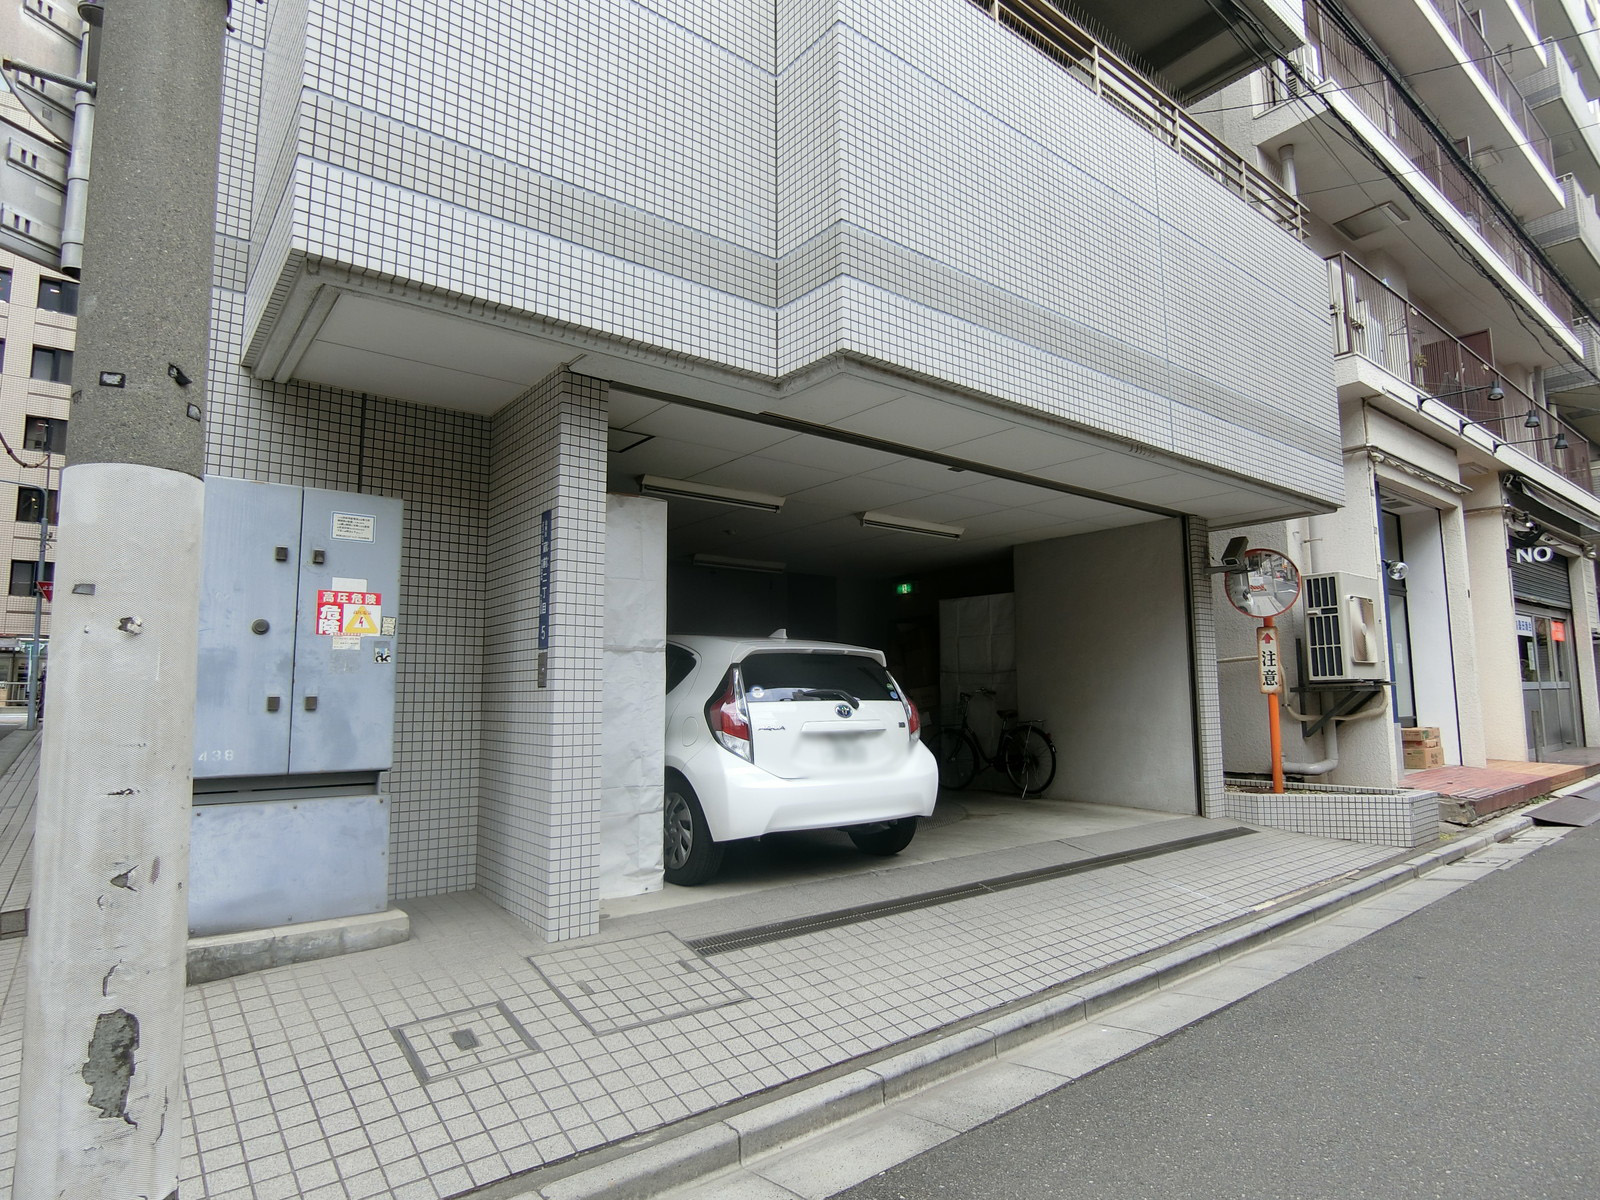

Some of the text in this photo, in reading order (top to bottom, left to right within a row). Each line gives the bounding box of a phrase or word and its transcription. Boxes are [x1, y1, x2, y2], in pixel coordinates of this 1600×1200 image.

[1515, 546, 1552, 563] NO
[323, 591, 377, 605] 高圧危険
[319, 604, 341, 636] 危険
[1262, 650, 1278, 686] 注意
